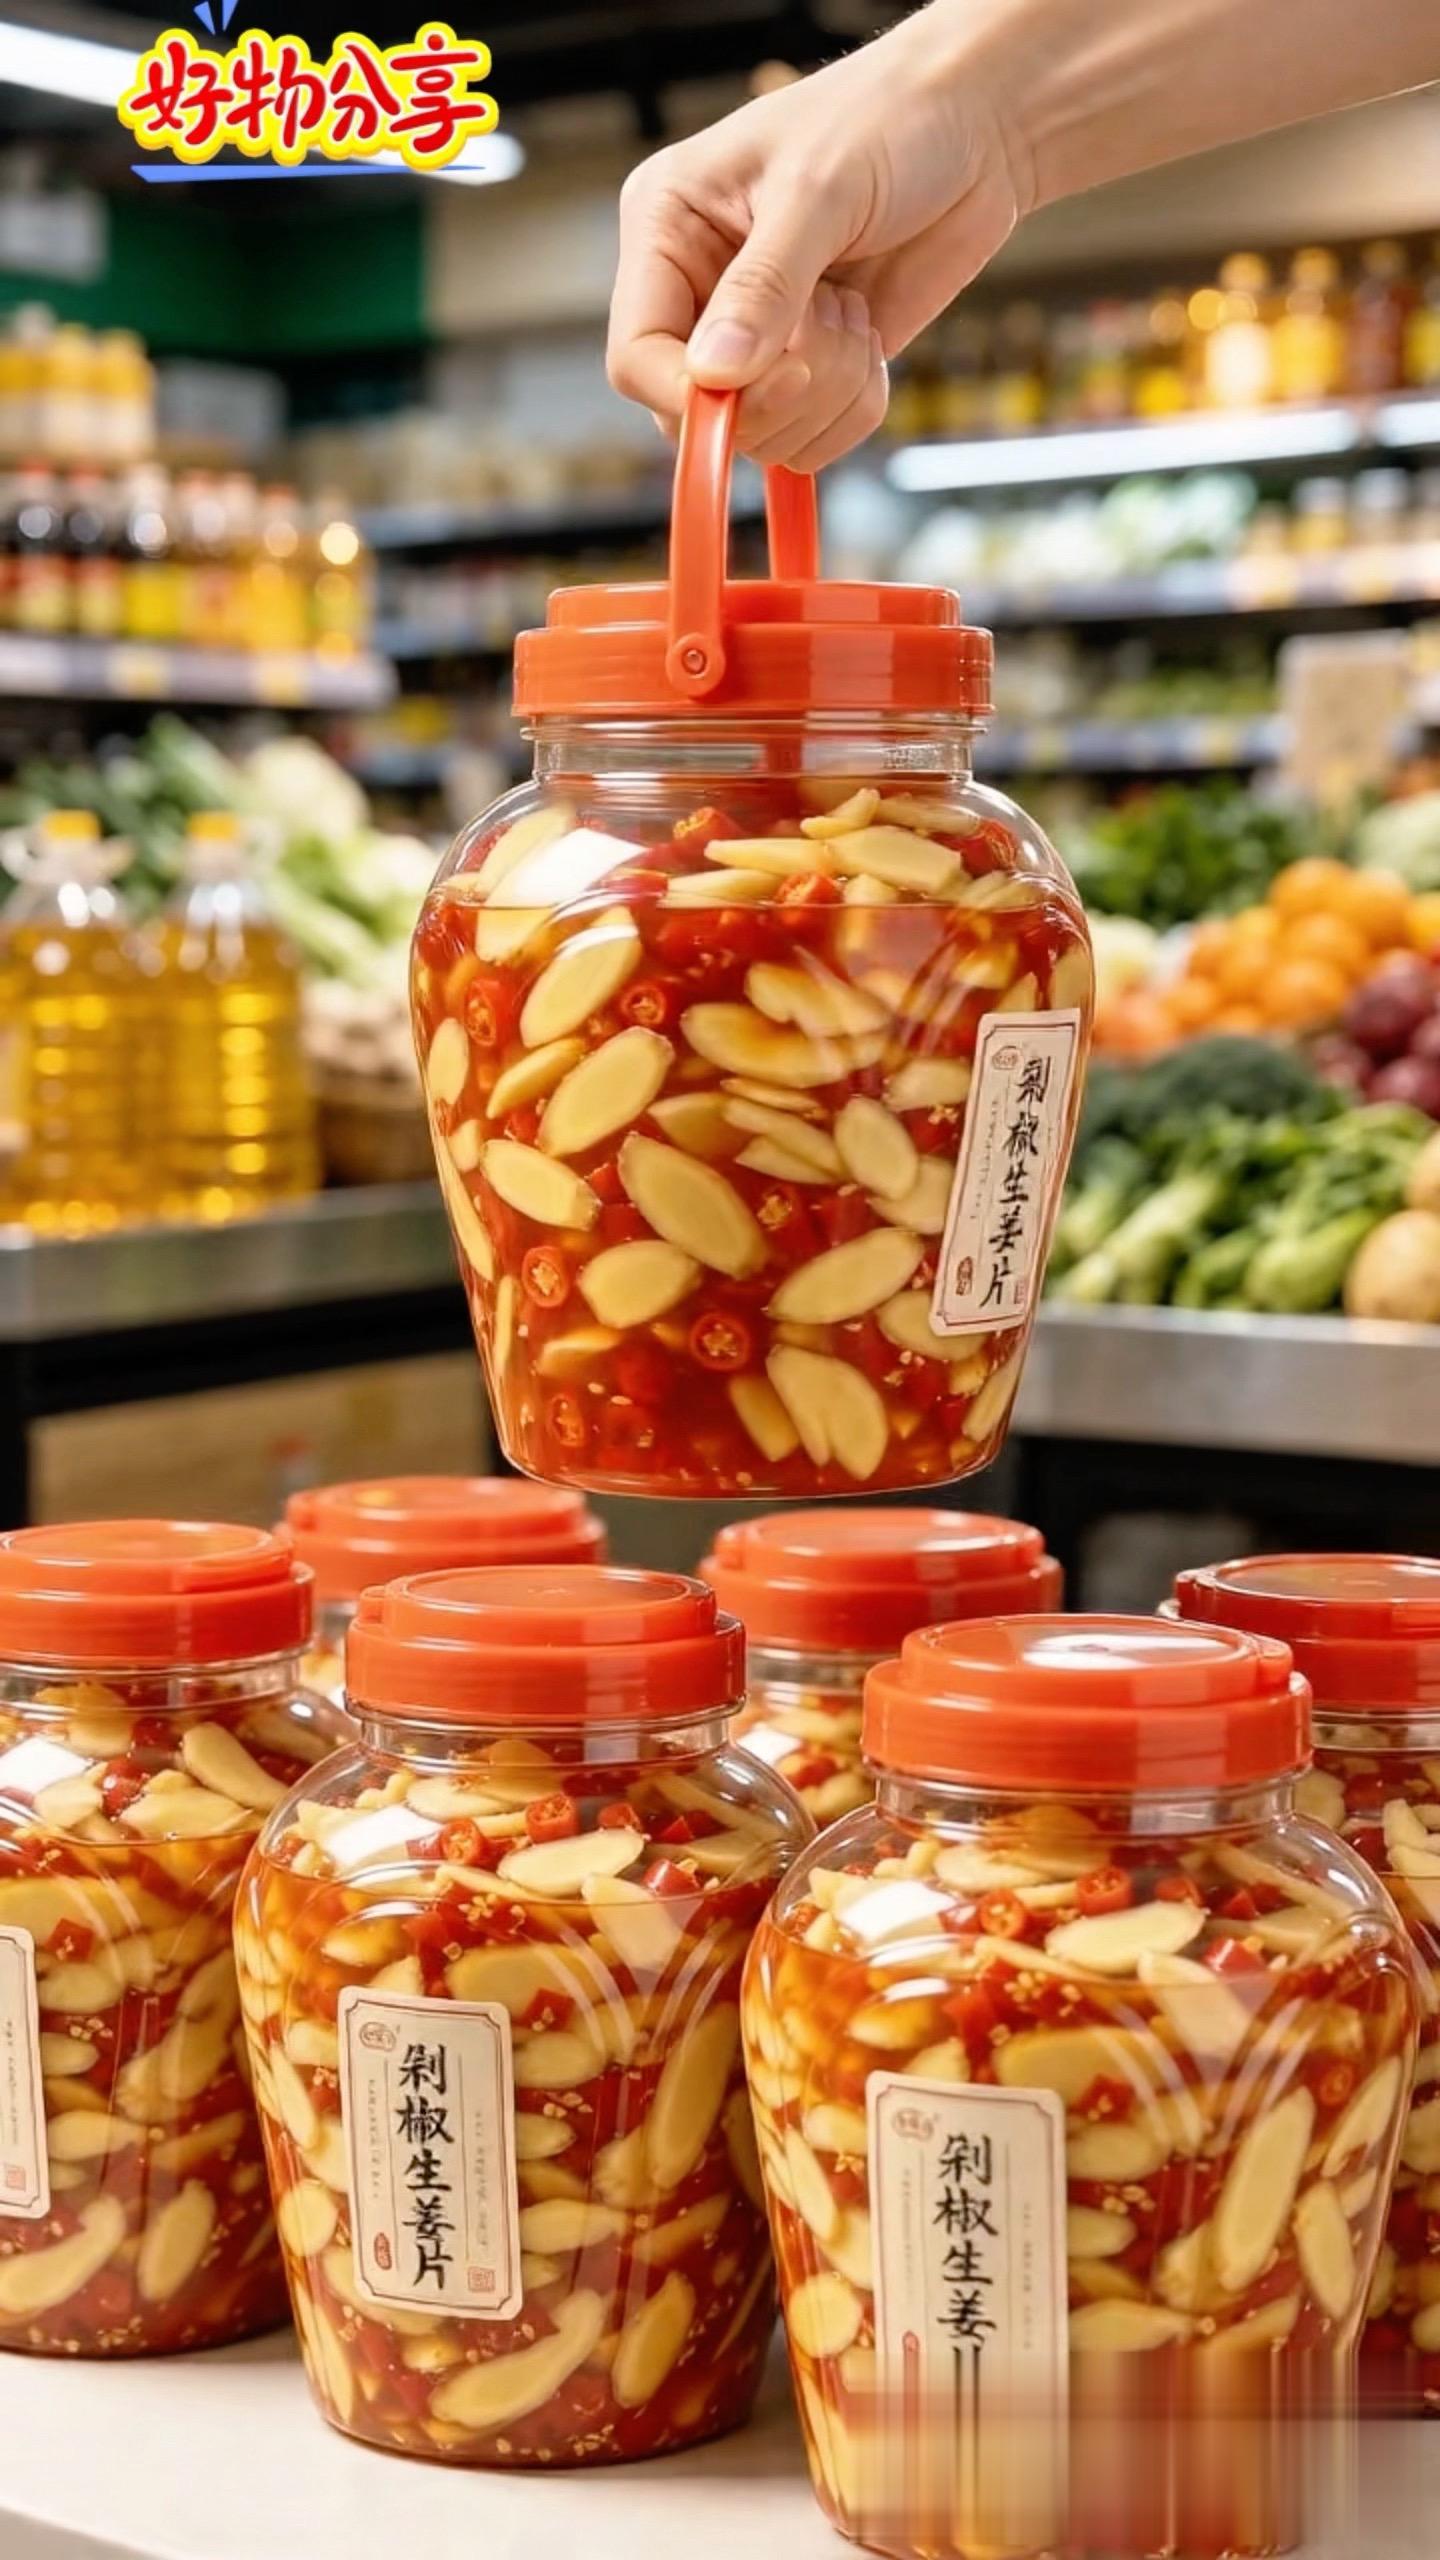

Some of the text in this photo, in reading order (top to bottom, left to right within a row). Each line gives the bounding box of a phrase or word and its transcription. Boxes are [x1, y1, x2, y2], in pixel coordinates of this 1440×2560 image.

[396, 2043, 455, 2290] 剁椒生姜片
[932, 2134, 999, 2385] 剁椒生姜
